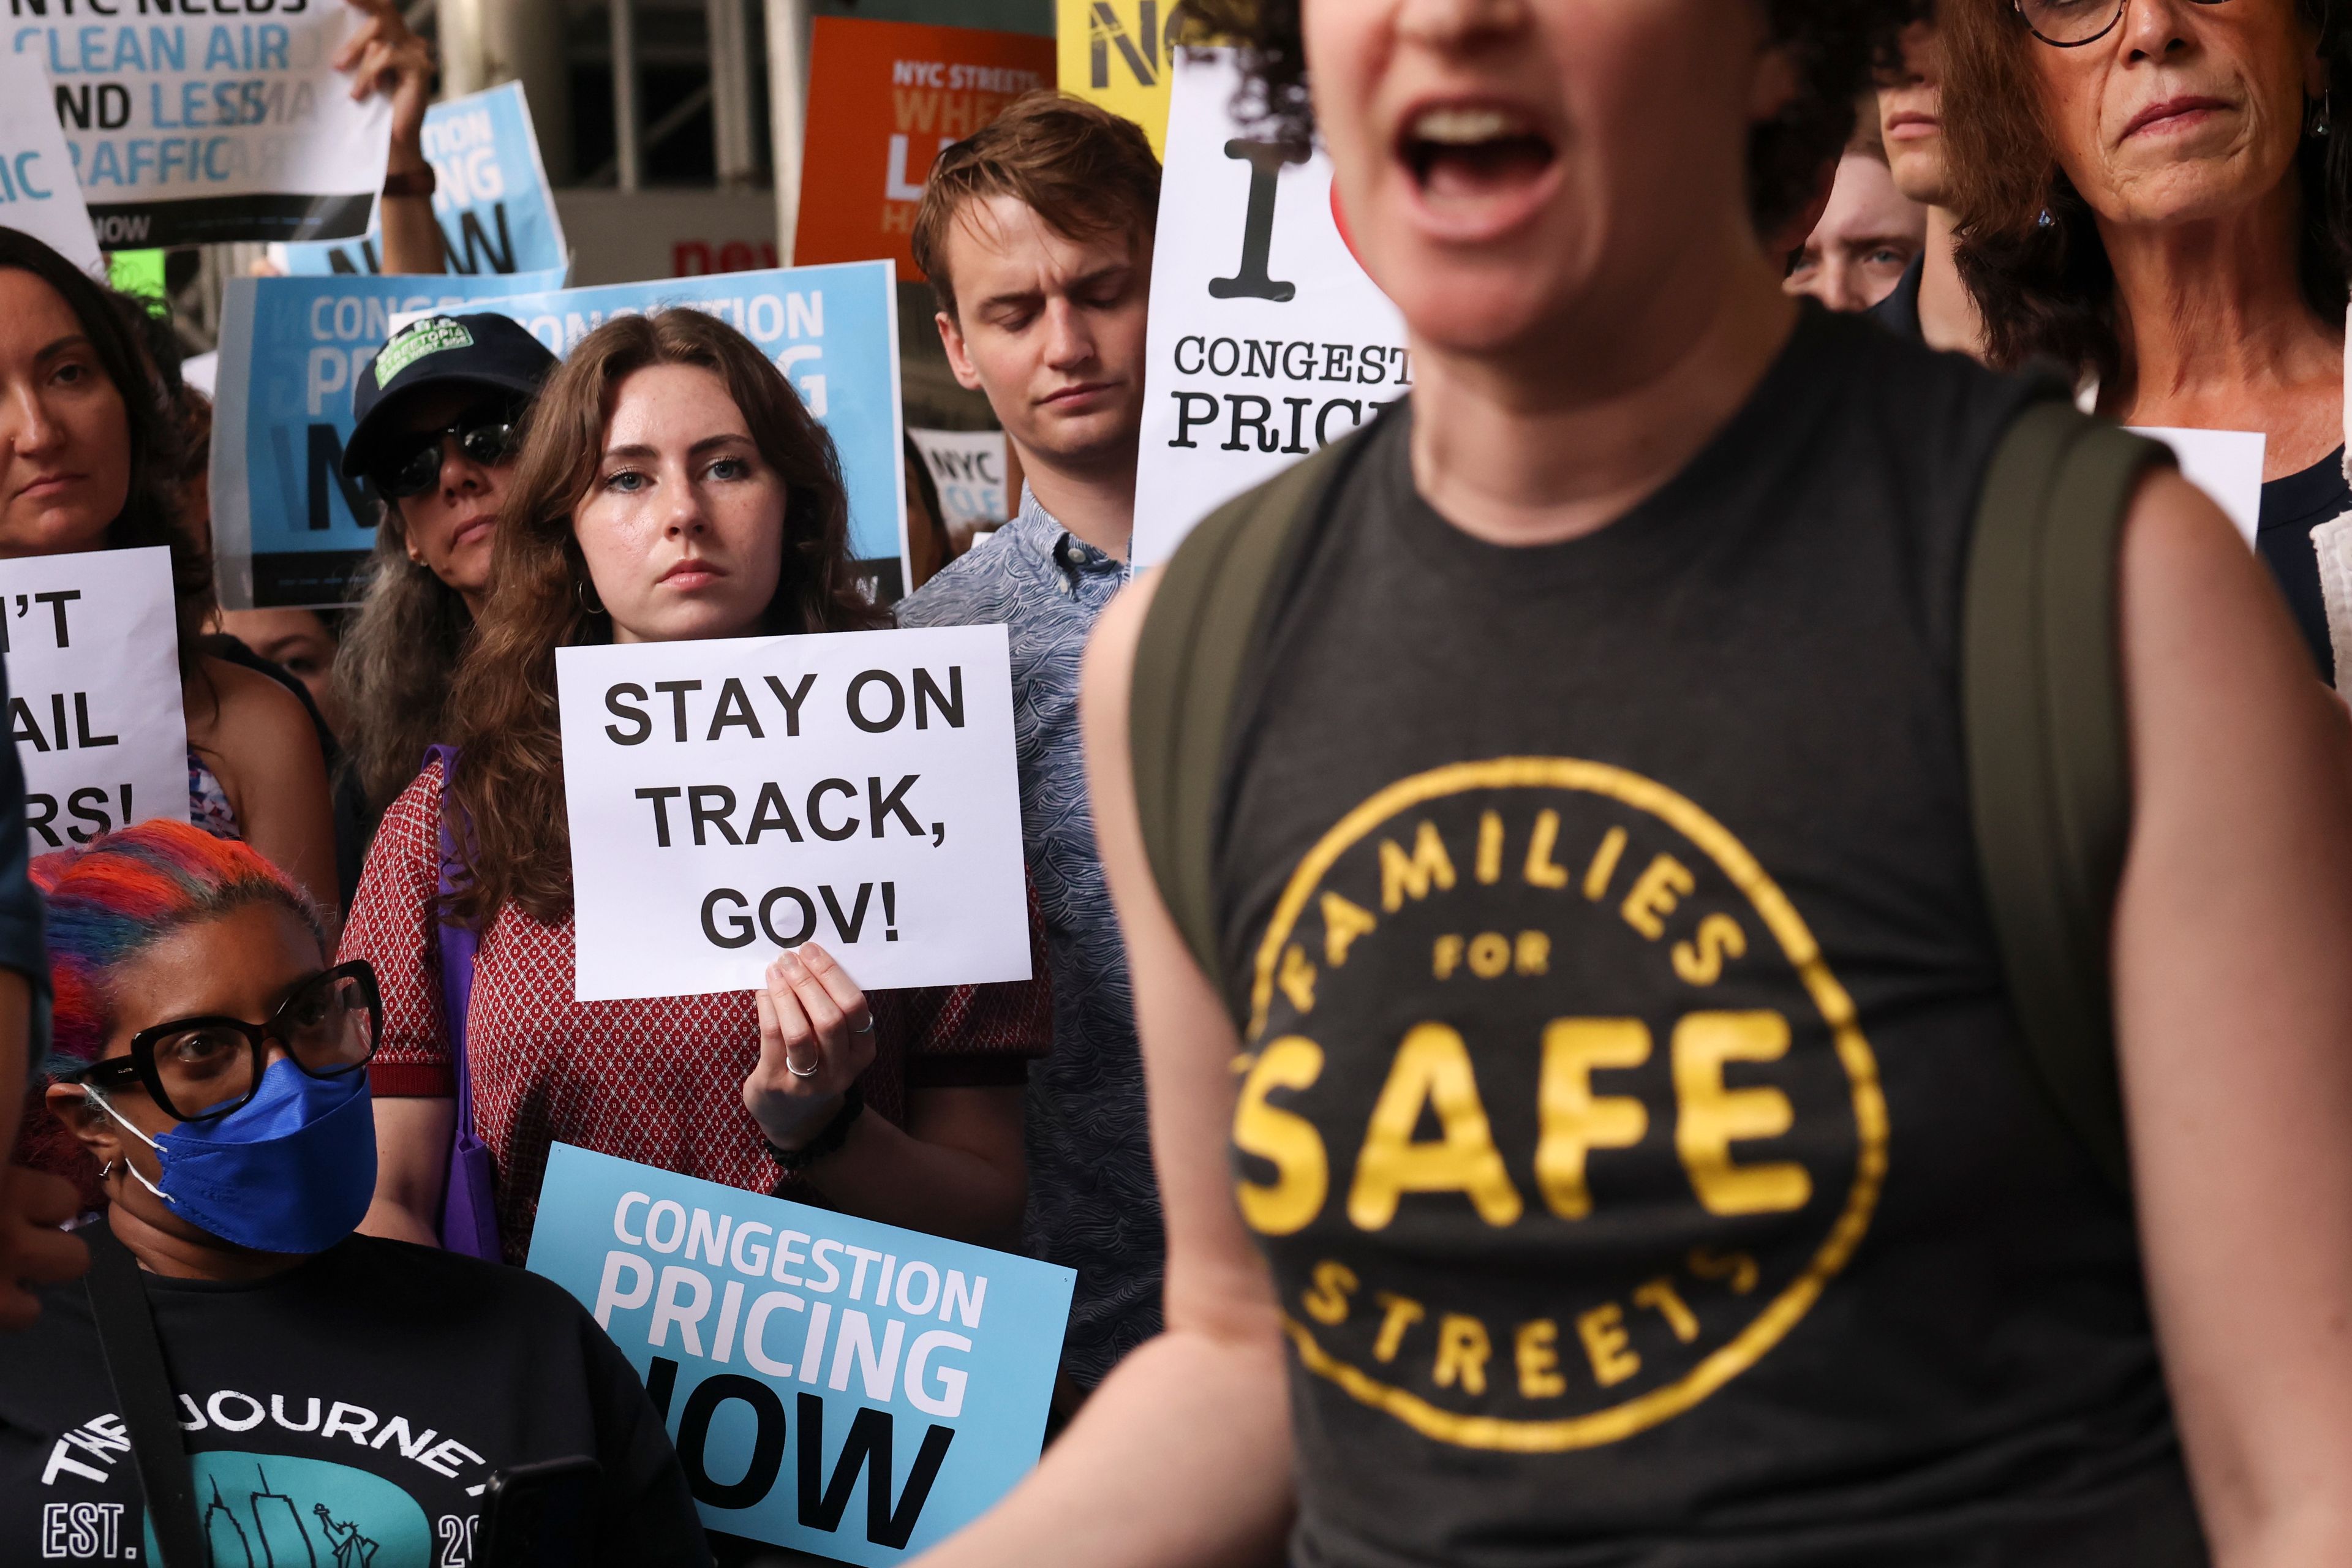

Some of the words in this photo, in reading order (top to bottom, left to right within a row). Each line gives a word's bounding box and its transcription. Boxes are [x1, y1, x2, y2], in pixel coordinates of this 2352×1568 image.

[205, 23, 290, 71] AIR
[892, 60, 946, 89] NYC
[1208, 137, 1313, 303] I
[931, 446, 1000, 484] NYC
[604, 673, 818, 745] STAY
[846, 666, 965, 734] ON
[635, 774, 945, 848] TRACK,
[700, 881, 899, 948] GOV!
[1276, 807, 1747, 1014] FAMILIES
[1432, 928, 1552, 981] FOR
[1231, 1008, 1813, 1236] SAFE
[612, 1190, 988, 1330] CONGESTION
[594, 1250, 973, 1419] PRICING
[1301, 1245, 1760, 1399] STREETS
[42, 1502, 137, 1560] EST.
